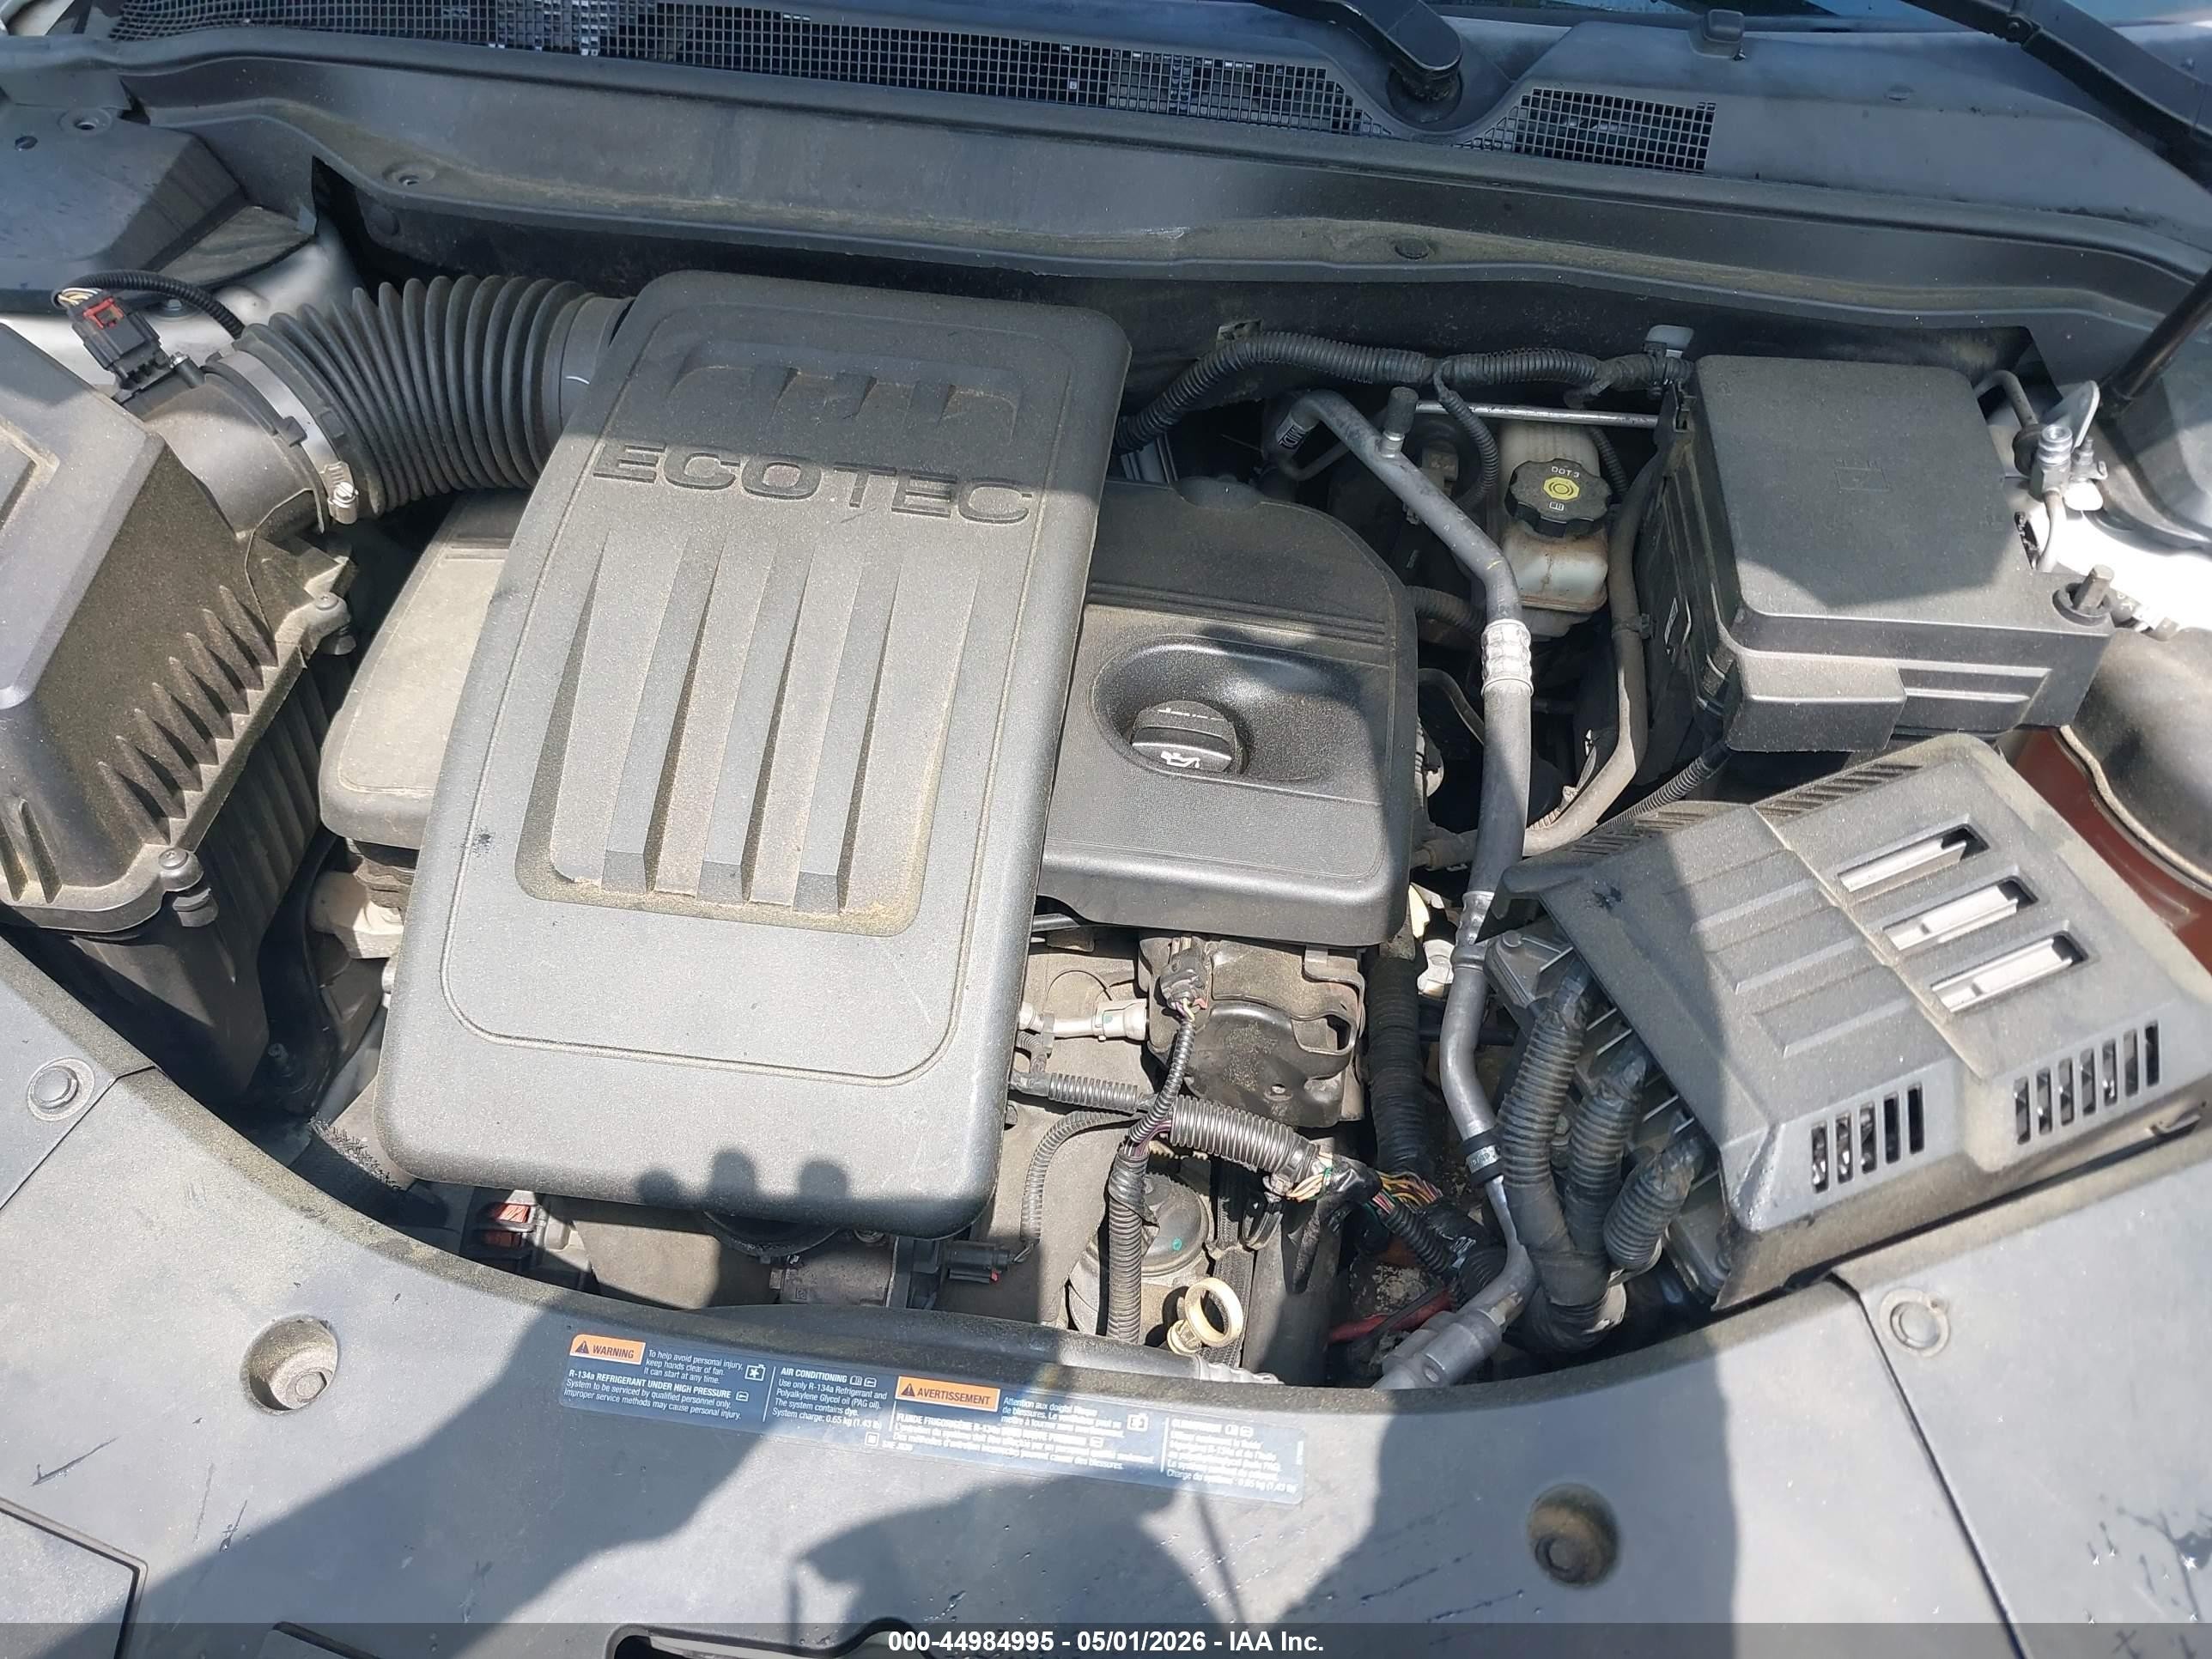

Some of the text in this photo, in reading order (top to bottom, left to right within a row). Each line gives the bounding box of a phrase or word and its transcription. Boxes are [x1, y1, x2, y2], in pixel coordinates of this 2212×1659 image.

[1551, 465, 1572, 477] DOT
[592, 441, 1034, 526] ECOTEC
[592, 1344, 635, 1358] WARNING
[657, 1351, 672, 1361] help
[672, 1352, 691, 1362] avoid
[692, 1355, 721, 1367] personal
[722, 1359, 743, 1370] injury,
[646, 1358, 725, 1376] keep hands clear of fan.
[780, 1366, 847, 1383] AIR CONDITIONING
[568, 1369, 731, 1399] R-134a REFRIGERANT UNDER HIGH PRESSURE
[664, 1370, 679, 1378] start
[689, 1374, 702, 1382] any
[702, 1375, 720, 1384] time.
[566, 1378, 592, 1389] System
[611, 1384, 640, 1395] serviced
[641, 1389, 650, 1398] by
[651, 1389, 679, 1402] qualified
[680, 1394, 714, 1407] personnel
[715, 1398, 732, 1409] only.
[775, 1388, 818, 1401] Polyalkylene
[818, 1394, 840, 1405] Glycol
[850, 1398, 867, 1407] (PAG
[777, 1378, 887, 1400] Use only R-134a Refrigerant and
[916, 1386, 991, 1407] AVERTISSEMENT
[563, 1388, 741, 1420] Improper service methods may cause personal injury.
[775, 1397, 860, 1418] The system contains dye.
[1002, 1405, 1012, 1414] de
[1003, 1396, 1034, 1410] Attention
[772, 1407, 798, 1419] System
[798, 1410, 825, 1423] charge:
[825, 1414, 842, 1424] 0.65
